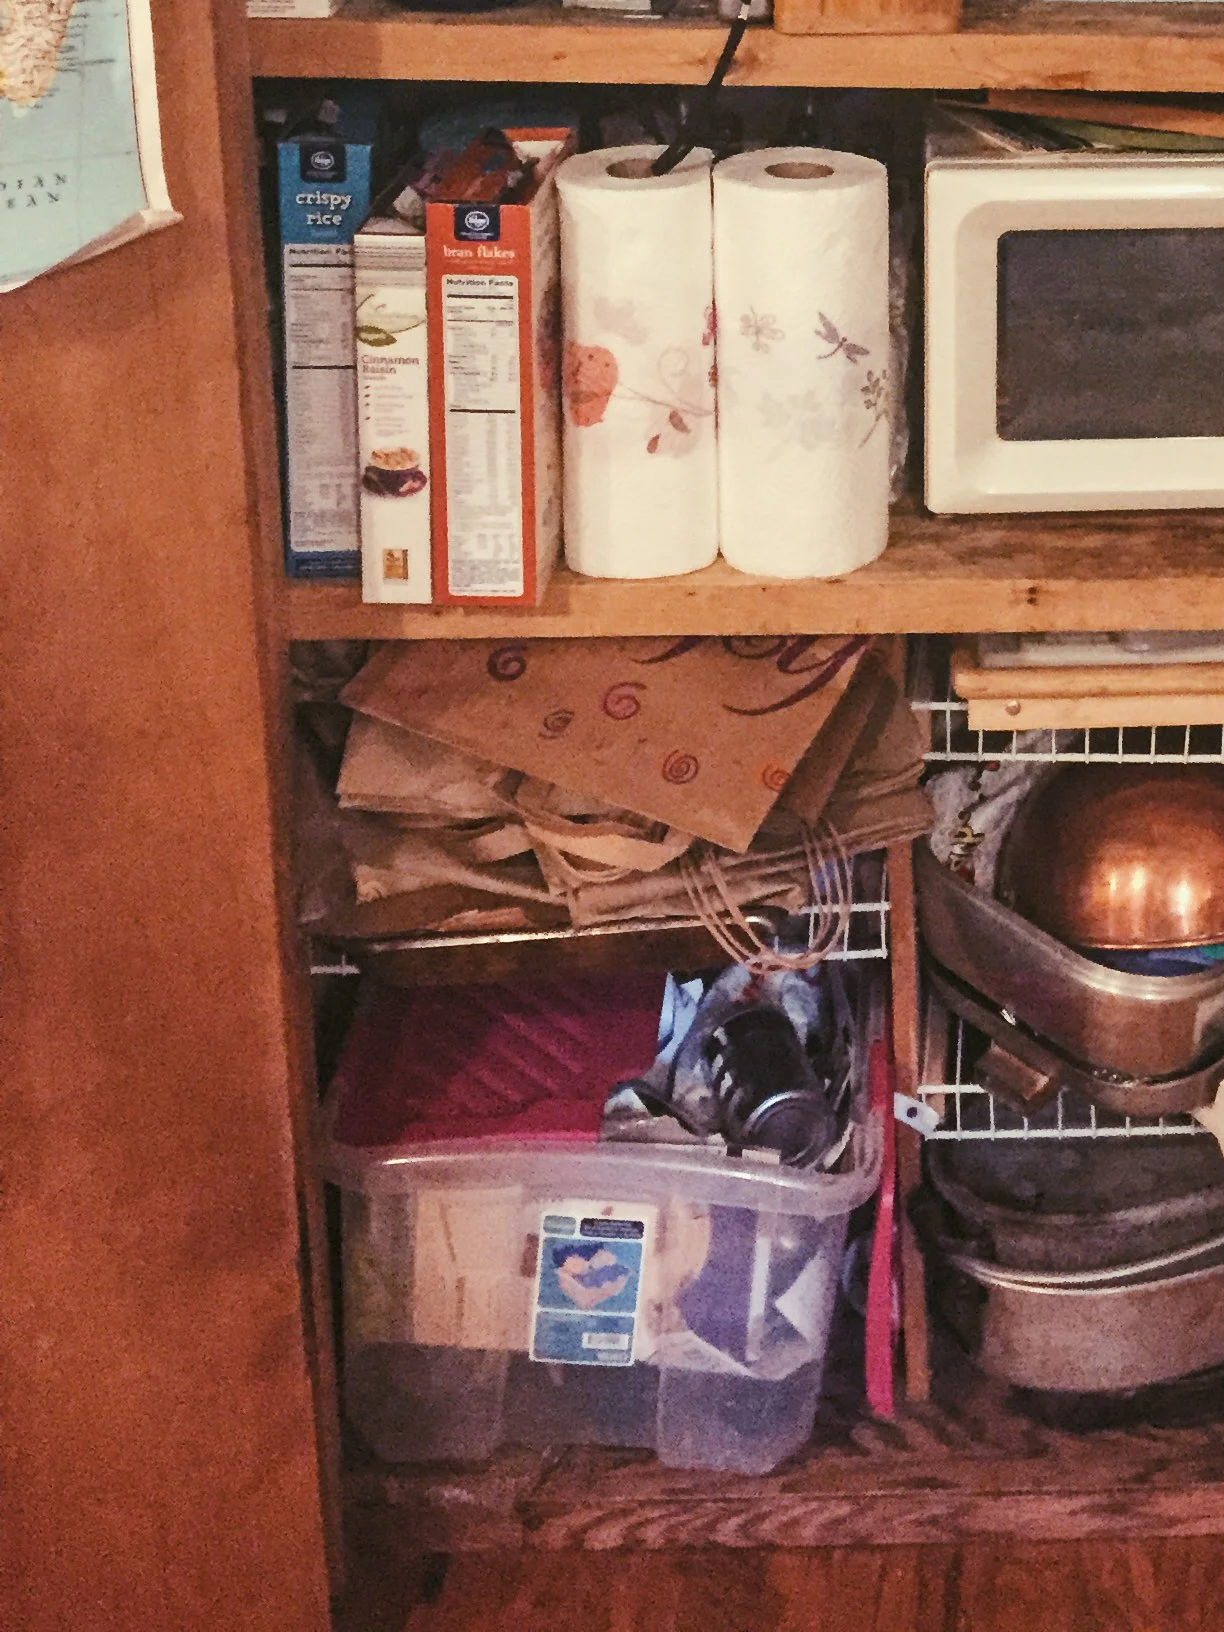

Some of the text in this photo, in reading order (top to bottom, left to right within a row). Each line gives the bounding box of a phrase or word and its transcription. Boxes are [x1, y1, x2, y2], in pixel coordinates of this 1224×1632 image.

[295, 190, 353, 210] crispy
[306, 212, 343, 226] rice
[443, 244, 516, 259] bran flakes
[361, 354, 420, 366] Cinnamon
[362, 366, 397, 375] Raisin
